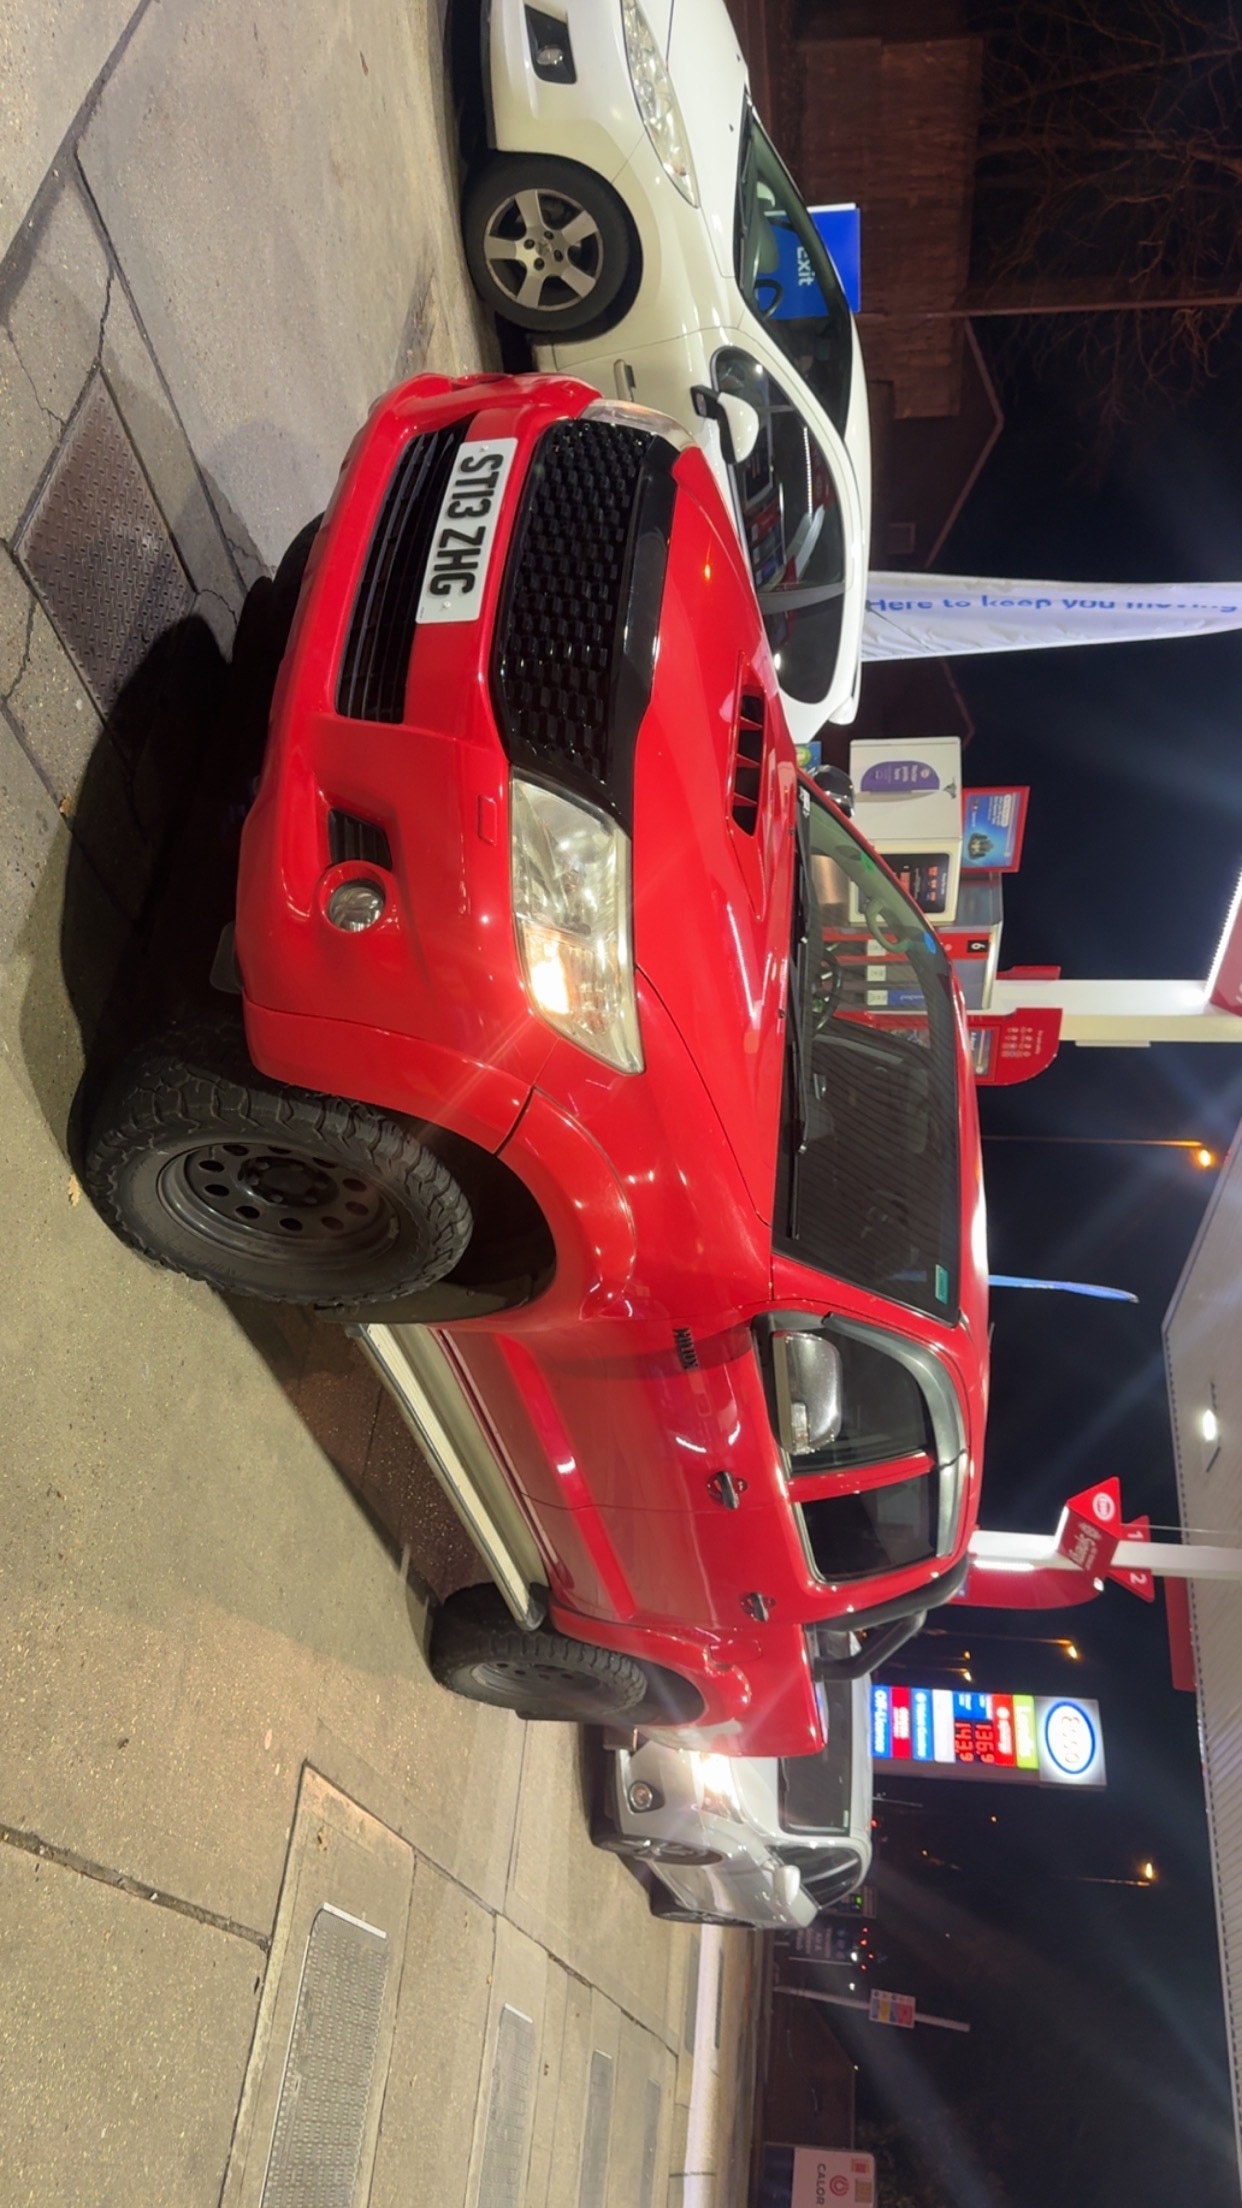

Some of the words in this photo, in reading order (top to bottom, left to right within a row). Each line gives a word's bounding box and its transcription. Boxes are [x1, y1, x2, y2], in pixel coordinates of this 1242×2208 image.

[796, 246, 816, 286] Exit
[447, 454, 504, 520] ST13
[430, 526, 486, 596] ZHG
[867, 600, 933, 611] Here
[944, 600, 972, 608] to
[981, 595, 1052, 608] keep
[1061, 600, 1116, 610] you
[970, 940, 986, 951] 6
[672, 1328, 698, 1370] HILUX
[1127, 1530, 1144, 1539] 1
[1130, 1572, 1147, 1584] 2
[955, 1723, 974, 1762] 143.9
[975, 1725, 994, 1763] 136.9
[816, 2163, 826, 2205] CALOR
